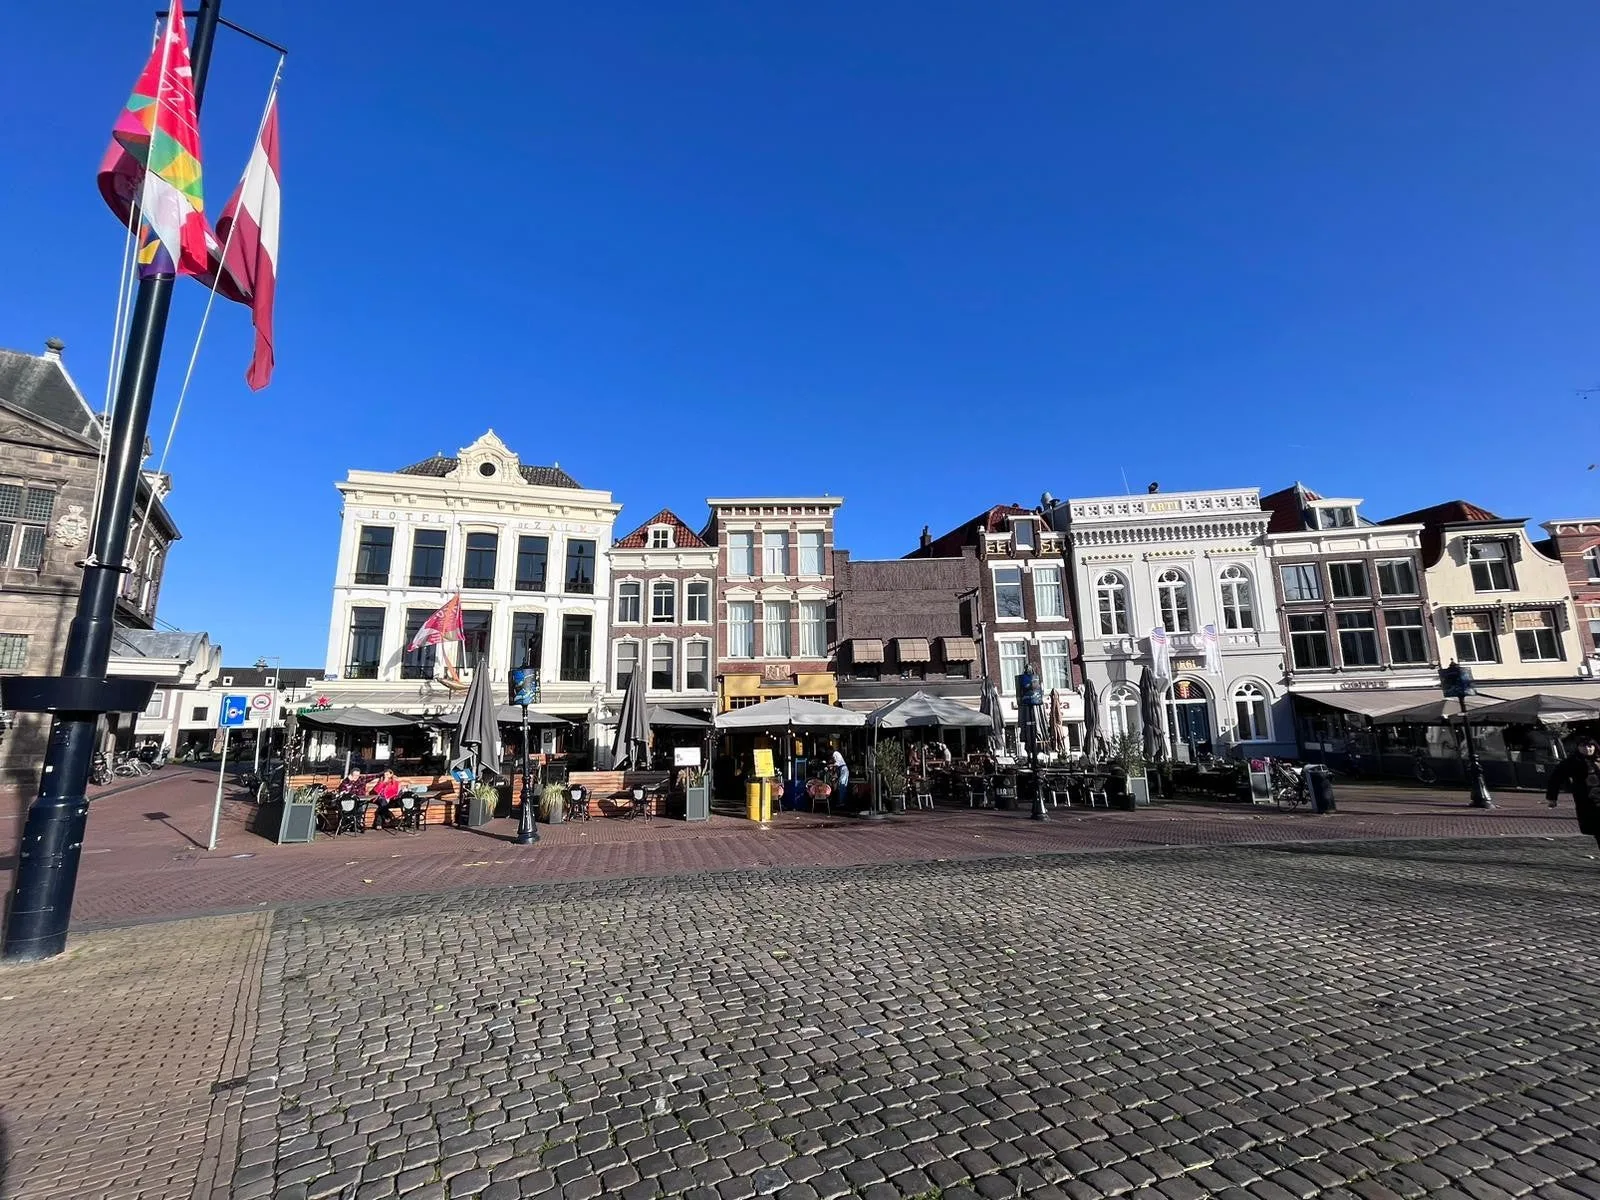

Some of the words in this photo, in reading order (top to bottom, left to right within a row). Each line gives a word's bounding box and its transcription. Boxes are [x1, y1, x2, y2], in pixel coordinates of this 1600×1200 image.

[1150, 501, 1179, 512] ARTI
[371, 510, 445, 523] HOTEL
[534, 522, 587, 533] ZALM
